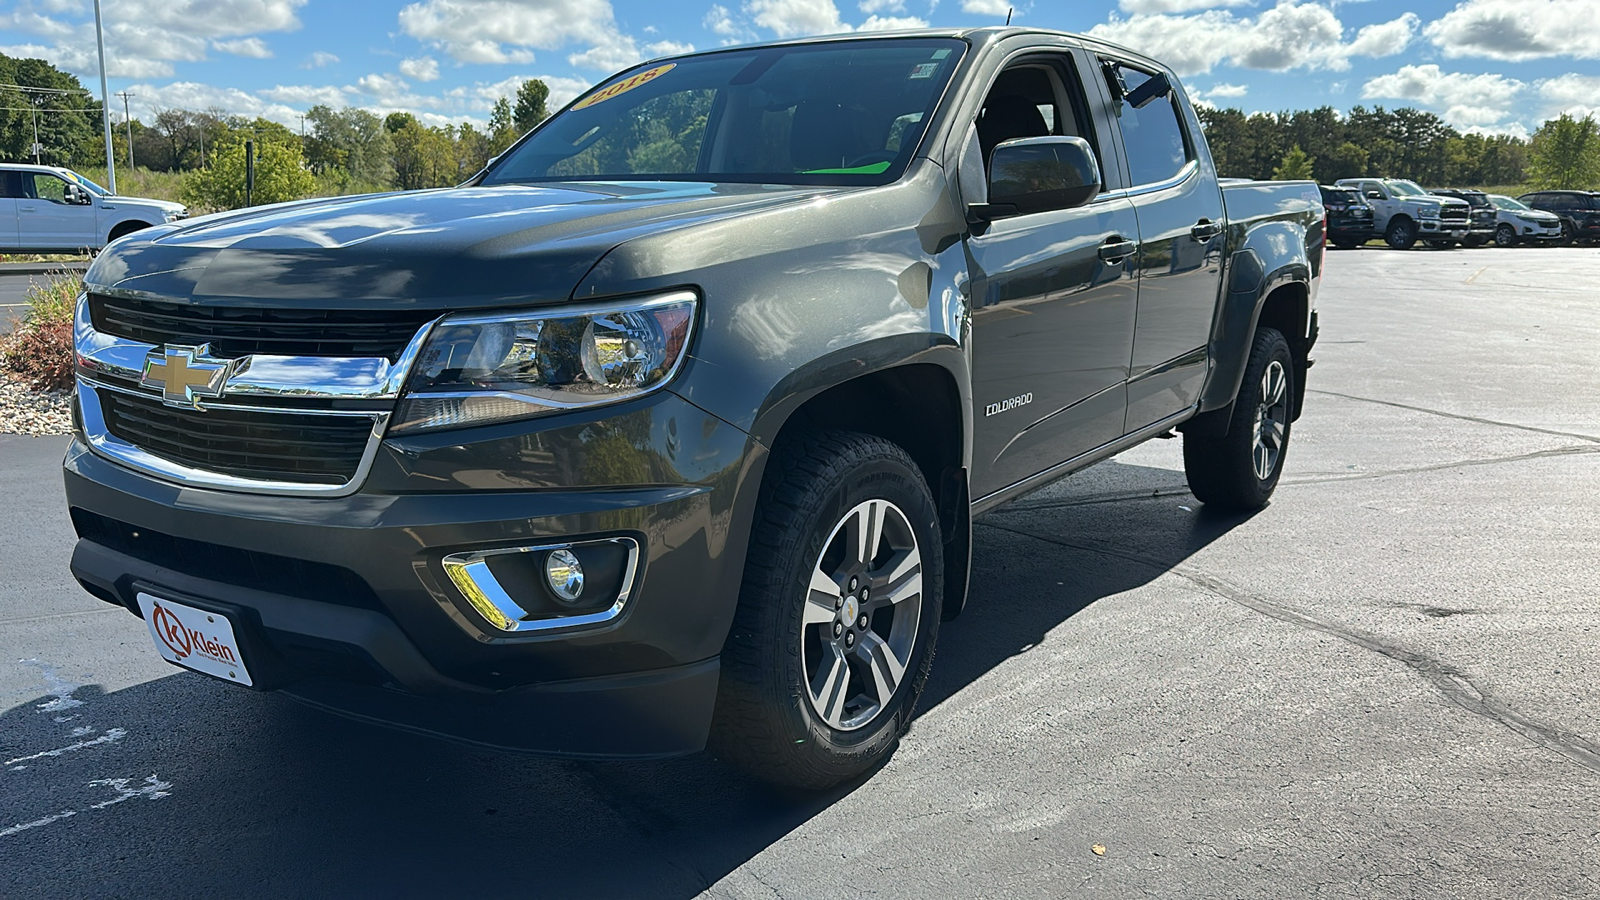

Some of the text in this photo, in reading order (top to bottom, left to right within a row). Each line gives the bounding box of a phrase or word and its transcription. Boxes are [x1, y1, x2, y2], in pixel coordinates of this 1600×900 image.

[588, 69, 659, 105] 2018
[986, 392, 1033, 417] COLORADO
[187, 628, 236, 662] Klein
